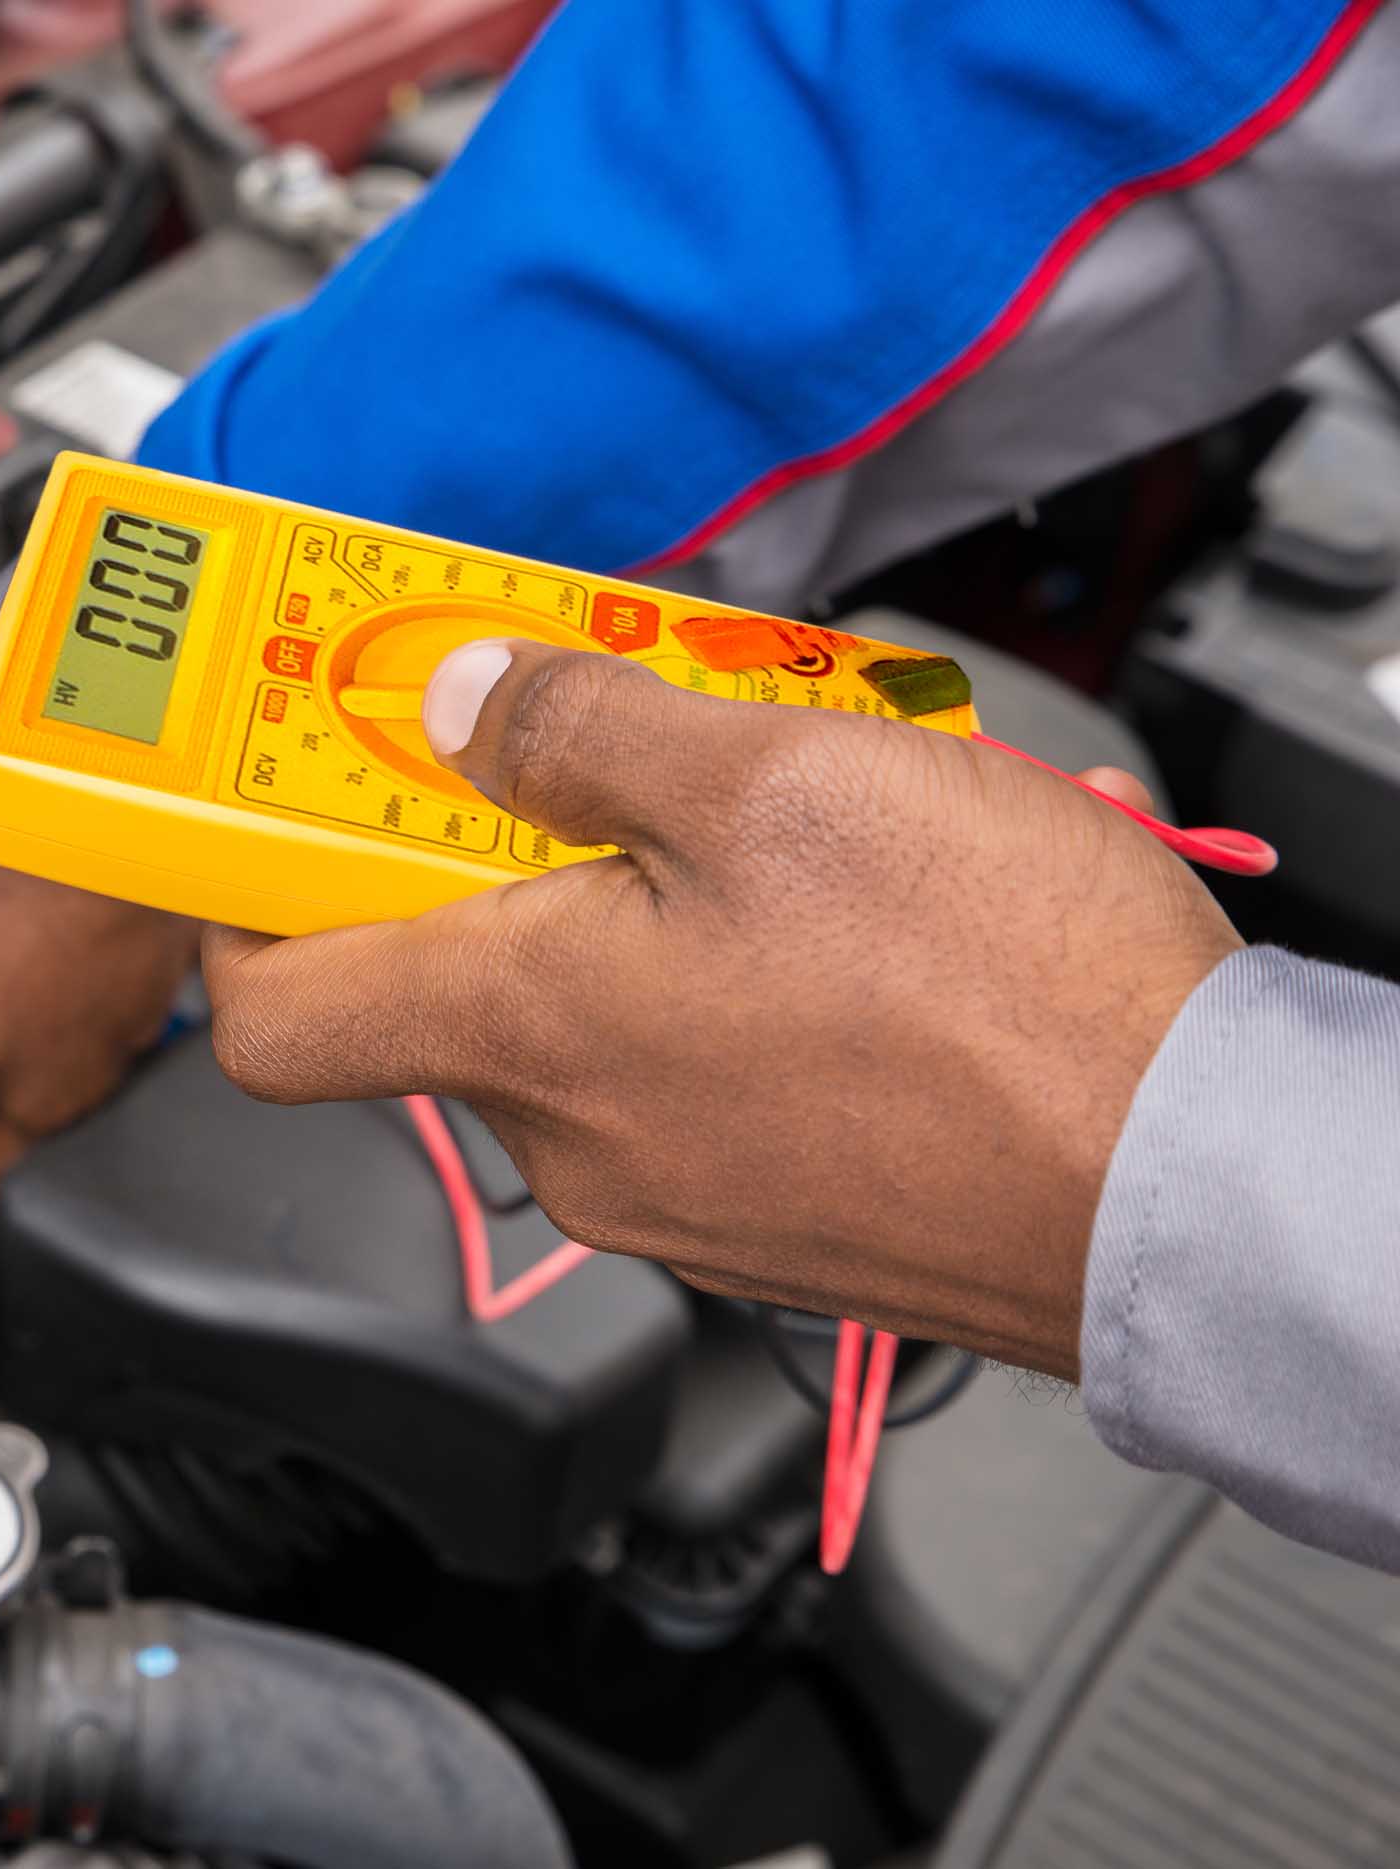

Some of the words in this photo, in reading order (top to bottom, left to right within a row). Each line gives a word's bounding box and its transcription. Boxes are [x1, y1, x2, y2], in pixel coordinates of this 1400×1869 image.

[303, 536, 325, 566] ACV
[360, 544, 384, 572] DCA
[75, 513, 201, 661] 000
[328, 588, 347, 605] 200
[287, 594, 309, 622] 750
[611, 606, 640, 636] 10A
[276, 641, 304, 673] OFF
[53, 678, 80, 707] HV
[264, 691, 286, 719] 1000
[301, 732, 319, 751] 200
[252, 753, 278, 787] DCV
